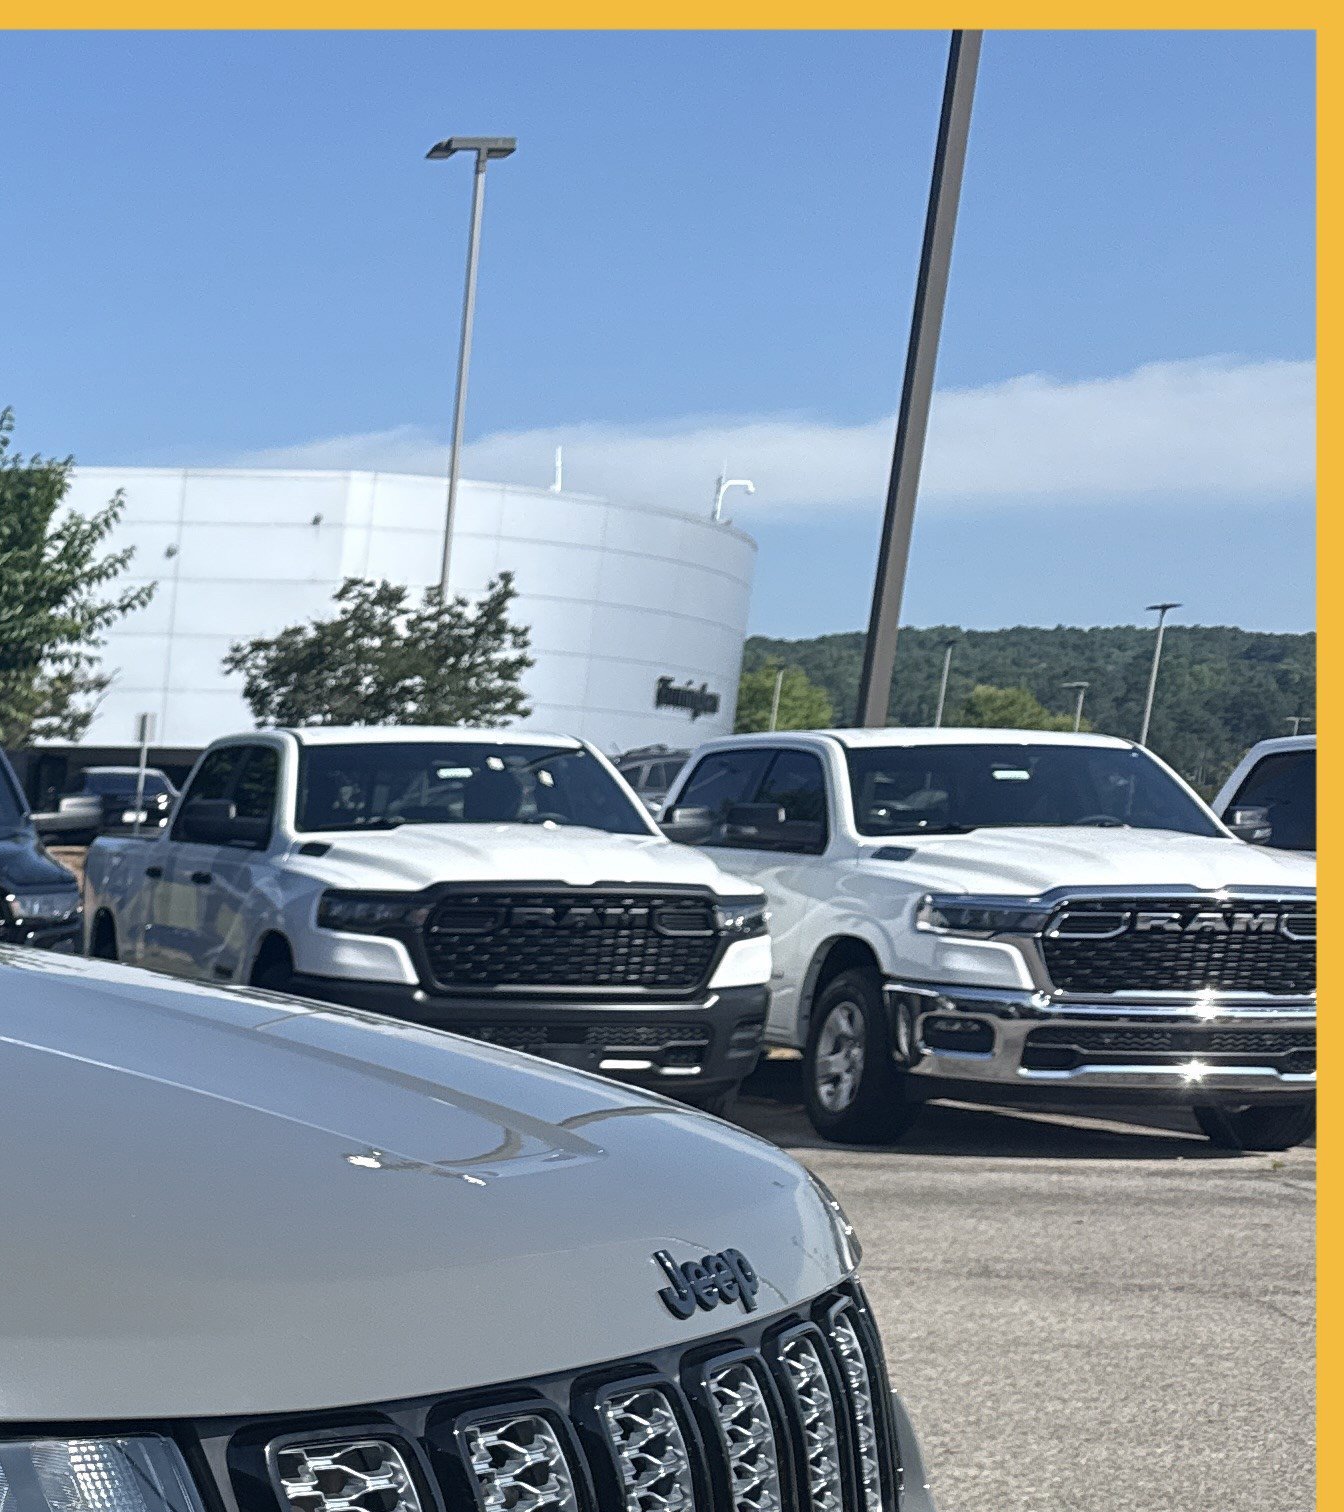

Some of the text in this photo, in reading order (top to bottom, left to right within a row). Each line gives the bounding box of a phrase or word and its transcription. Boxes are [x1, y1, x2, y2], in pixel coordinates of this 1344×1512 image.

[511, 907, 649, 928] RAM
[1135, 912, 1278, 932] RAM
[653, 1248, 759, 1320] Jeep
